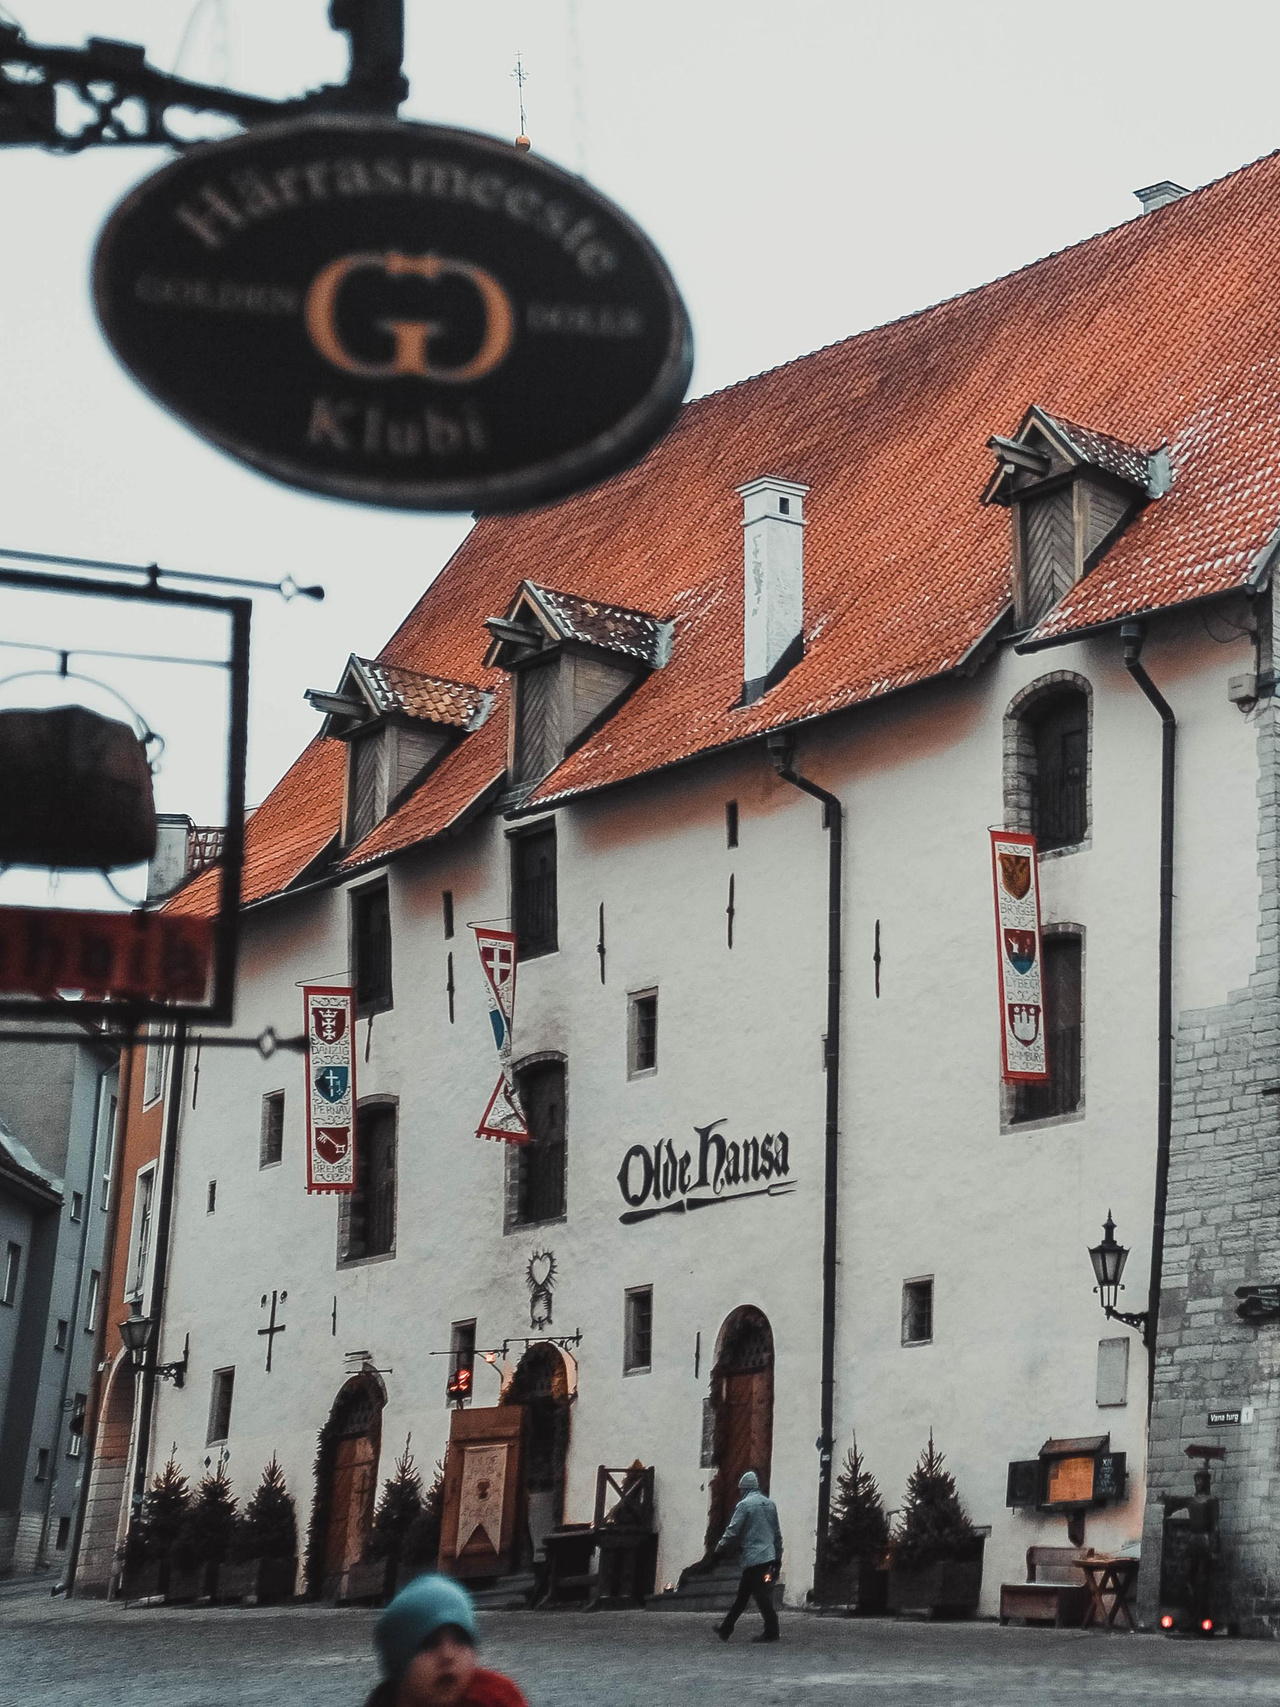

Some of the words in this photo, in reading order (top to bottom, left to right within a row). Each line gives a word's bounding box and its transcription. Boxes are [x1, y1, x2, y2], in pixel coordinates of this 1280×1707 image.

[307, 397, 488, 454] Klubi
[311, 1045, 349, 1056] DANZIG
[617, 1138, 691, 1207] Olde
[1225, 1412, 1239, 1423] turg
